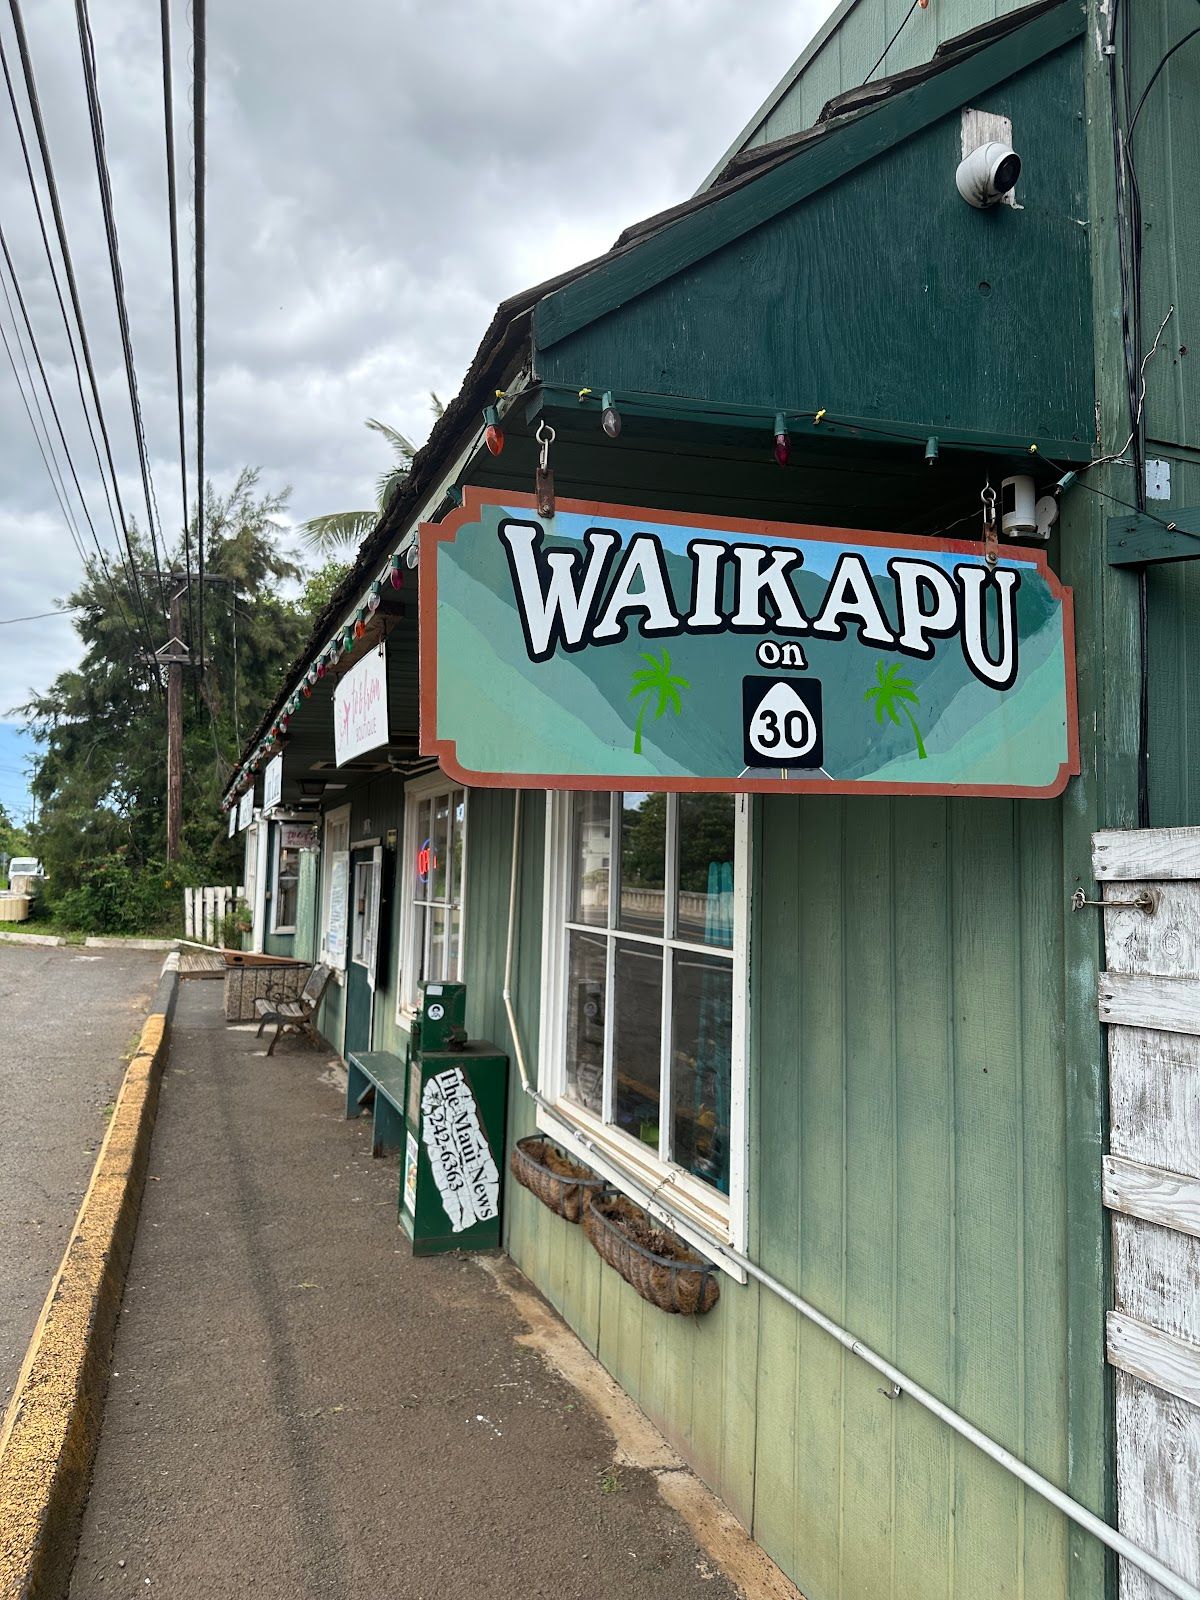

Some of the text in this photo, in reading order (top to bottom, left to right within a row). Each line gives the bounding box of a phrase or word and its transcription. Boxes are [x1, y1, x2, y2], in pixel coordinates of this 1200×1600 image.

[499, 519, 1020, 690] WAIKAPU
[757, 641, 806, 668] on
[757, 709, 809, 749] 30
[429, 1112, 465, 1192] 242-6363
[440, 1070, 493, 1219] The Maui News
